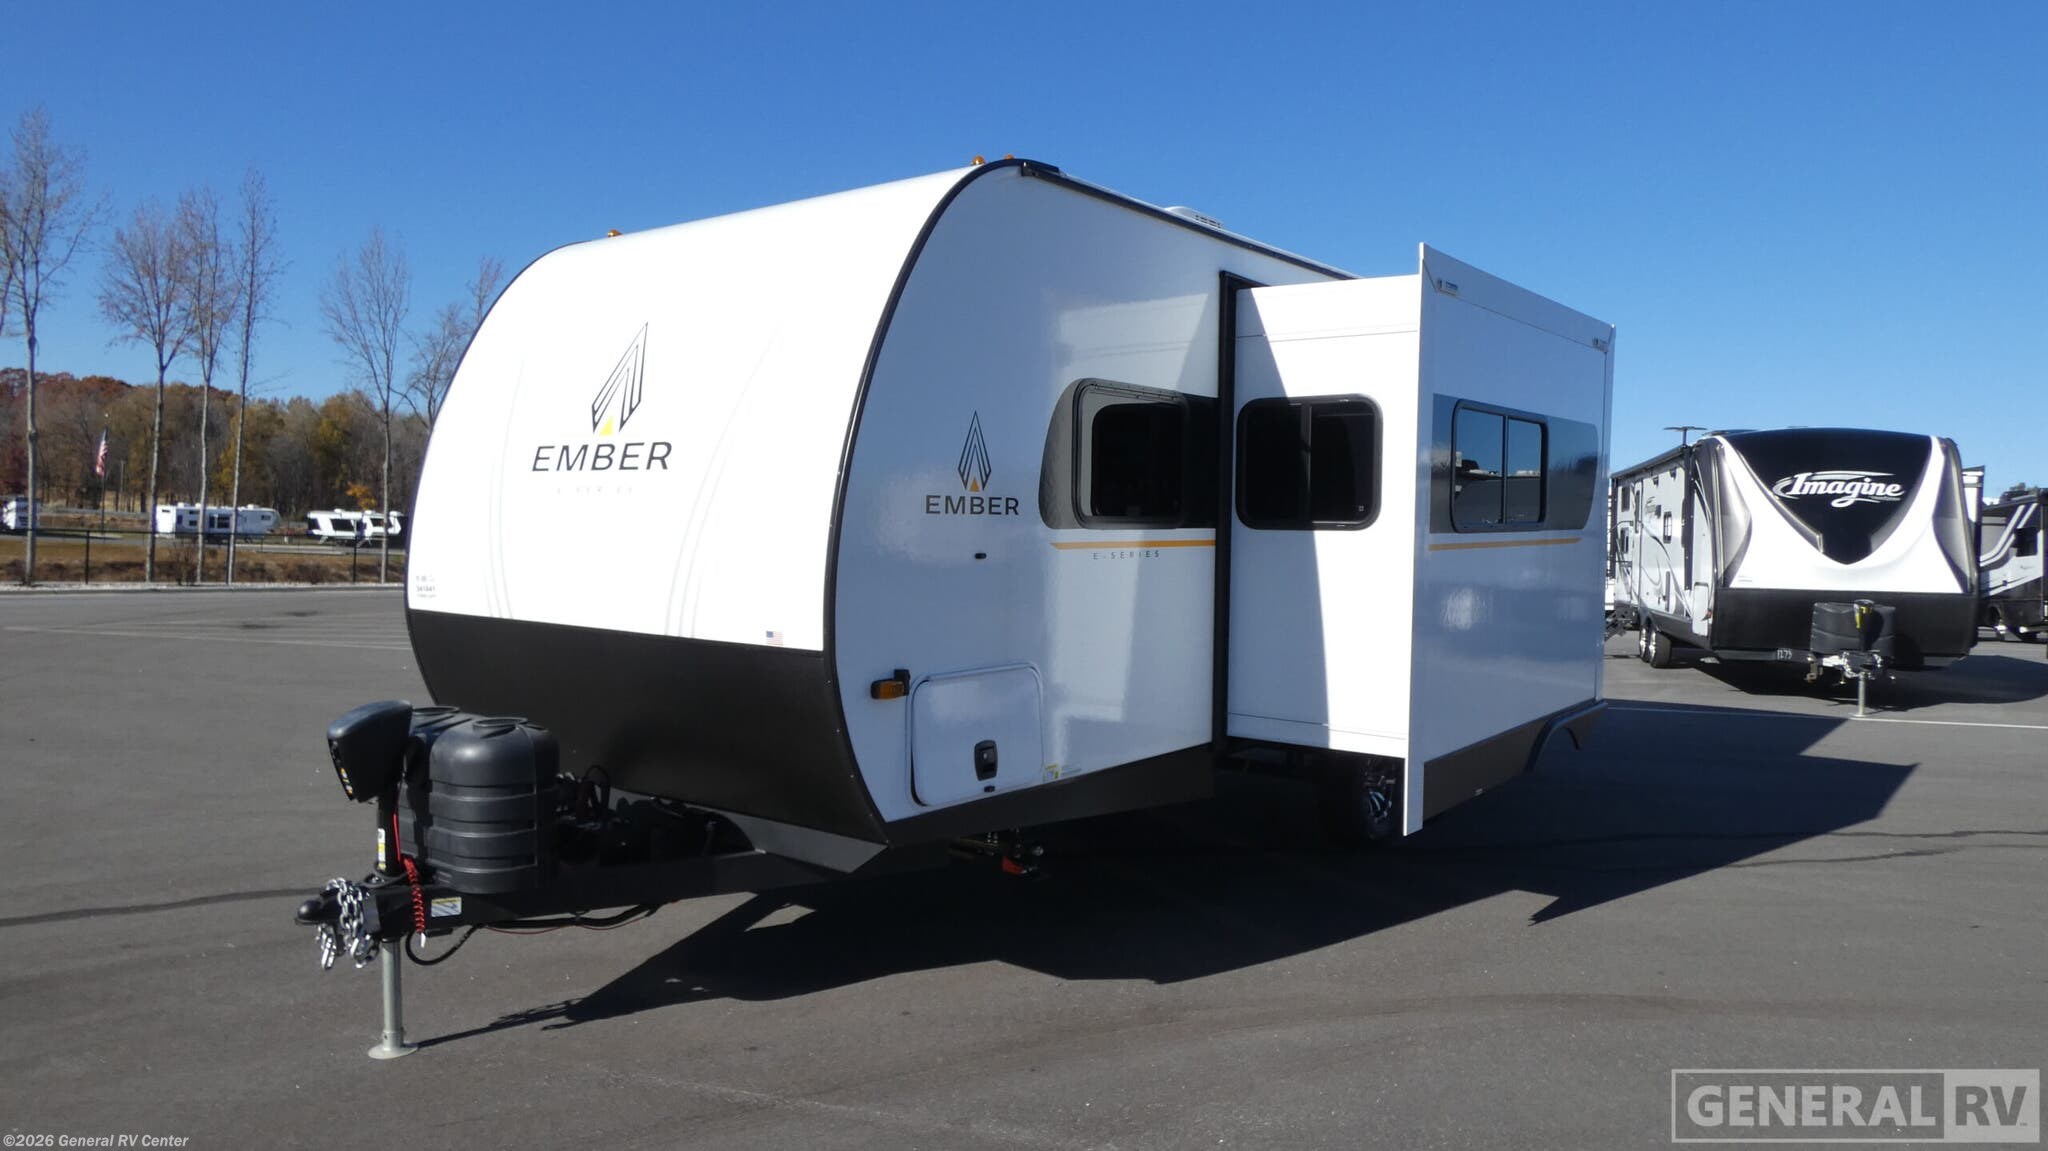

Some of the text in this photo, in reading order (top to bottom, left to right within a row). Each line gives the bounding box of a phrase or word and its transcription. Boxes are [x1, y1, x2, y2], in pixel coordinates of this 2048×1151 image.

[531, 441, 673, 472] EMBER
[925, 494, 1020, 516] EMBER
[1785, 471, 1906, 508] Imagine
